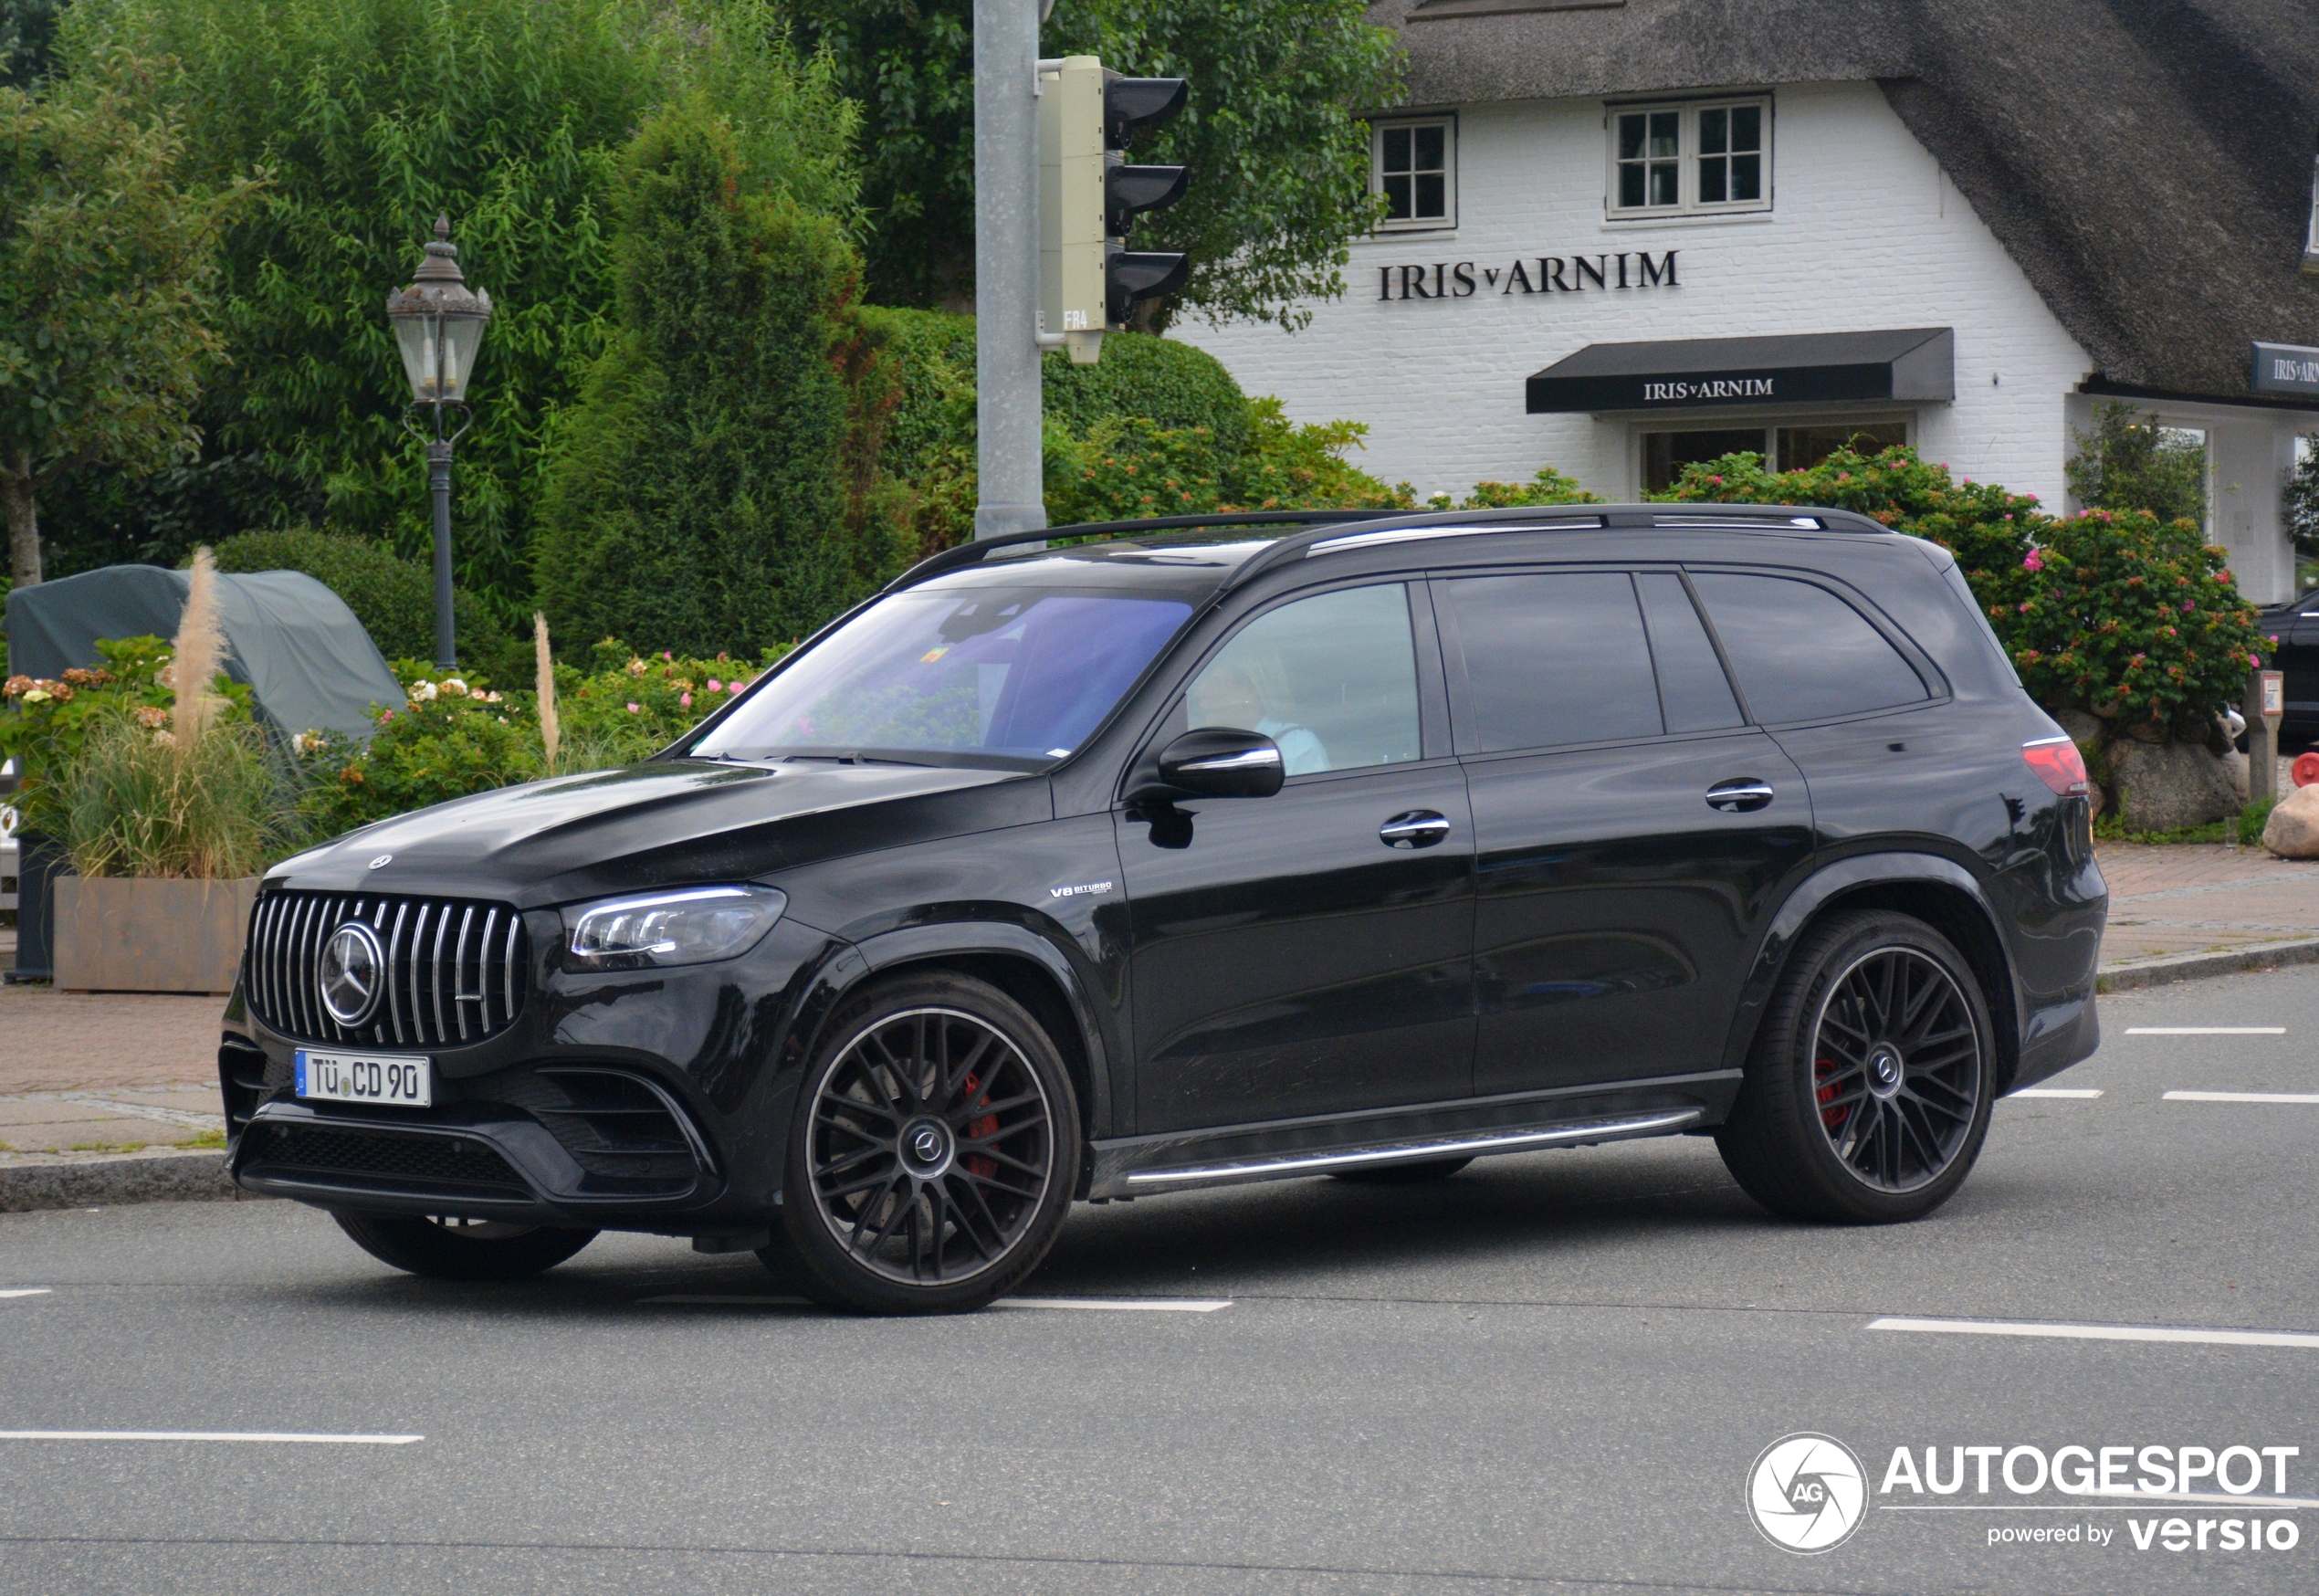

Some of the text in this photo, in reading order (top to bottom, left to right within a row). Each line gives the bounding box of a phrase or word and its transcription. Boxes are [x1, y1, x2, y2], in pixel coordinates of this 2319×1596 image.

[1064, 310, 1088, 330] FR4
[1050, 887, 1074, 898] V8
[352, 1061, 382, 1097] CD
[387, 1064, 418, 1099] 90
